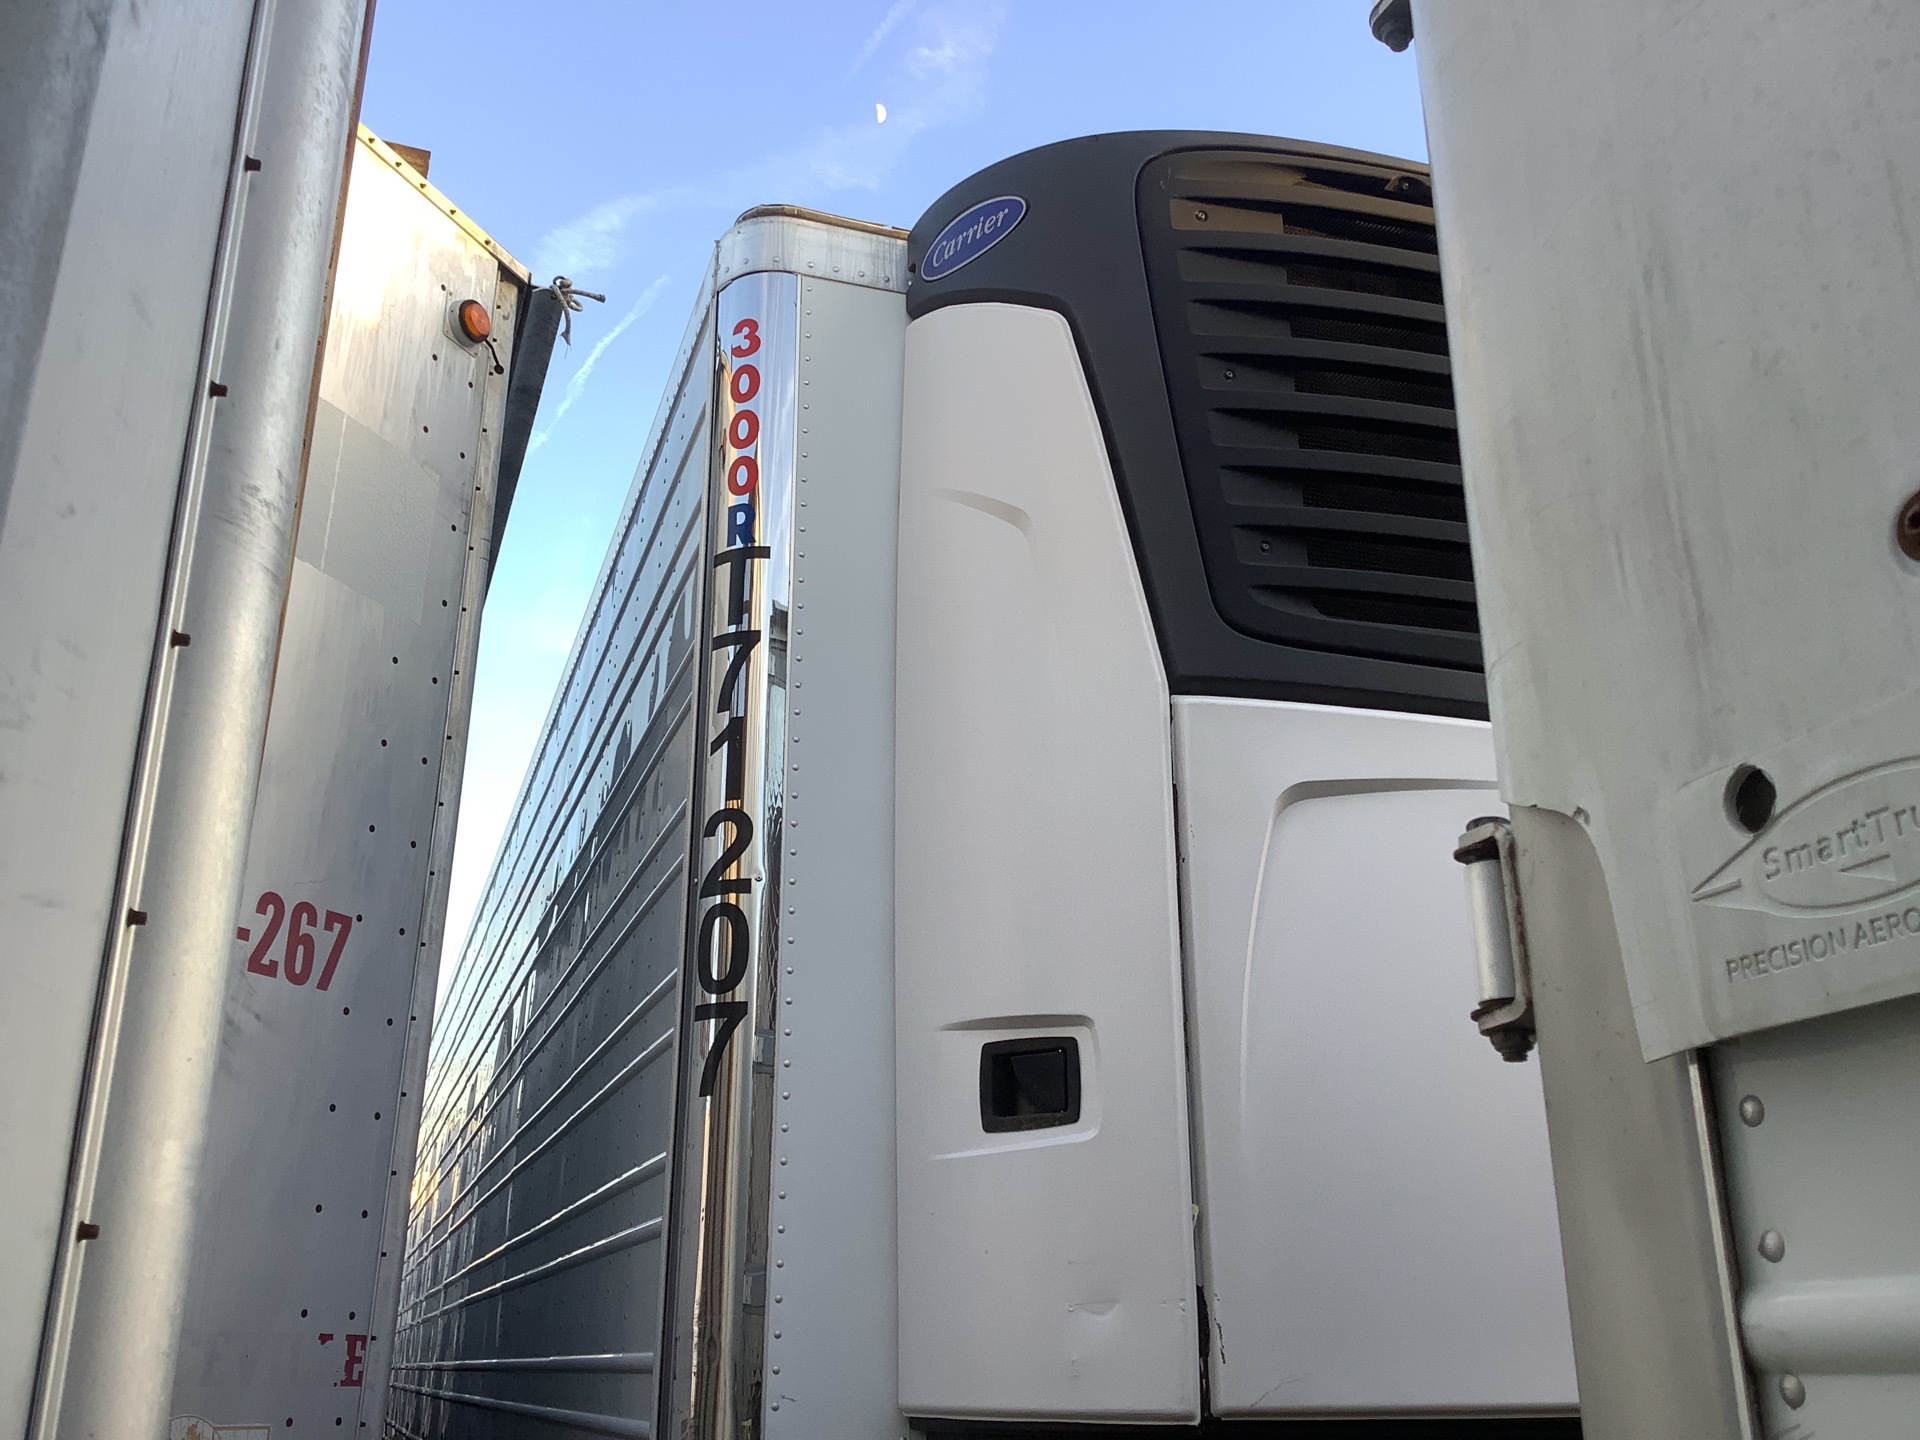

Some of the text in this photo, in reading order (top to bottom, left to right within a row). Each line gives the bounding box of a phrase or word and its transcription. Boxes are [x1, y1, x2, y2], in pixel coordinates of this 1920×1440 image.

[932, 208, 1009, 268] Carrier
[236, 891, 353, 992] -267
[1726, 926, 1847, 984] PRECISION
